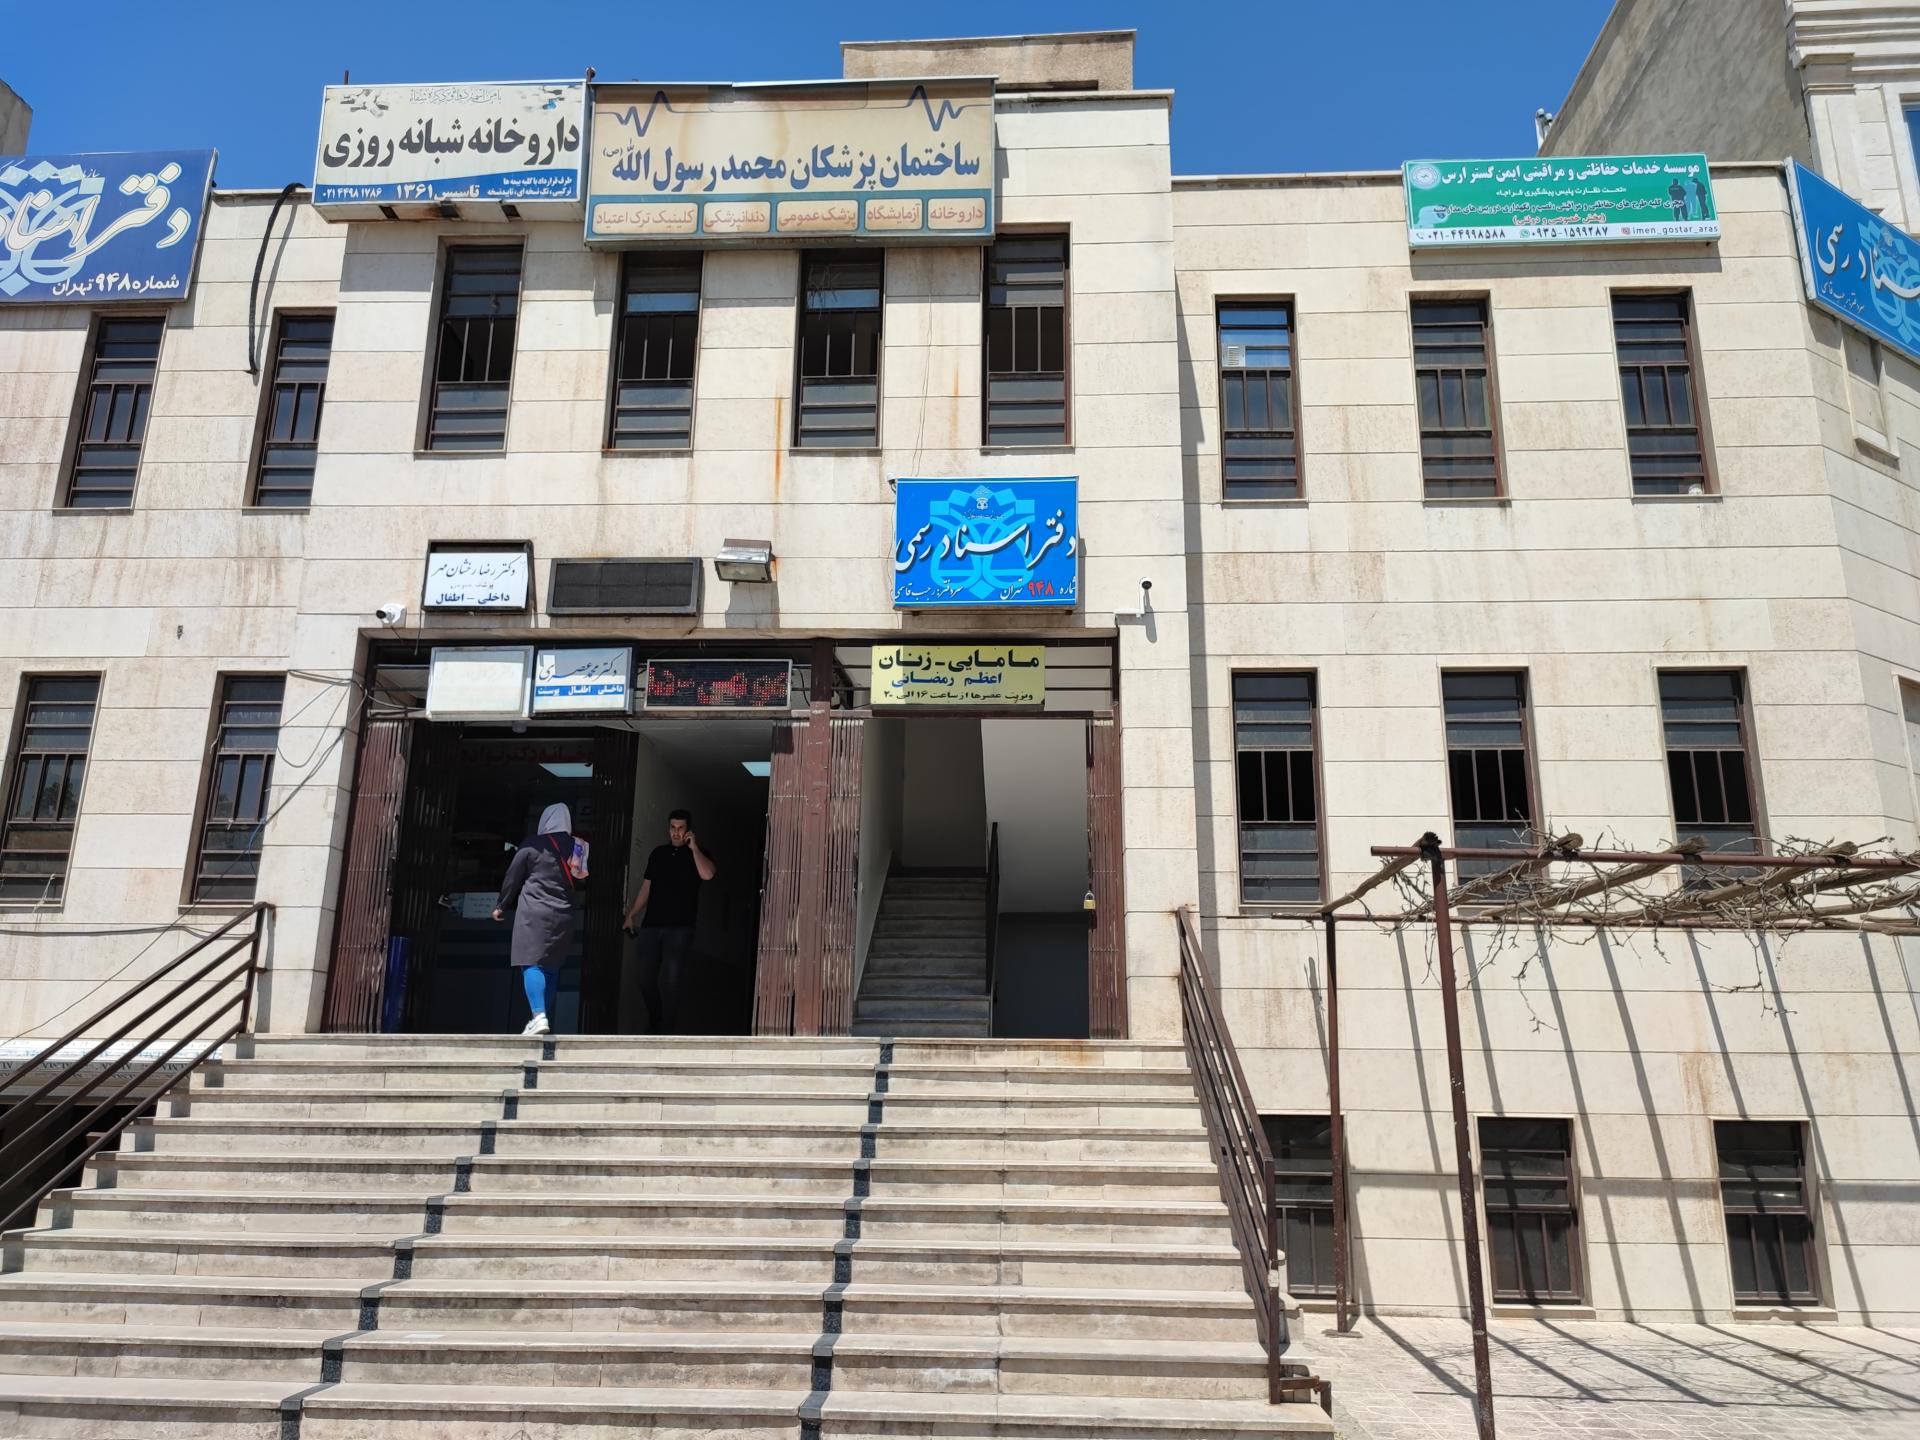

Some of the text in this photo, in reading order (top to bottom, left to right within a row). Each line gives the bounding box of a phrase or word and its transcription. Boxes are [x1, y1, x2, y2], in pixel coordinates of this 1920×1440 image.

[323, 116, 580, 168] داروخانه شبانه روزی
[612, 138, 651, 181] الله
[652, 146, 718, 192] رسول
[721, 154, 787, 181] محمد
[790, 144, 876, 191] پزشکان
[879, 141, 980, 188] ساختمان
[1441, 161, 1700, 184] موسسه خدمات حفاظتی و مراقبتی ایمن گستر ارس
[396, 183, 433, 200] ۱۳۶۱
[0, 162, 191, 263] دفتر اسنا
[596, 209, 695, 229] کلینیک ترک اعتیاد
[704, 209, 766, 231] دندانپزشکی
[778, 206, 856, 228] پزشک عمومی
[866, 203, 921, 224] آزمایشگاه
[929, 206, 984, 224] داروخانه
[1632, 225, 1718, 236] imen_gostar_aras
[52, 272, 180, 296] شماره ۹۴۸ تهران
[895, 509, 1076, 571] دفتر اسناد رسمی
[494, 554, 522, 580] دکتر
[435, 593, 465, 605] اطفال
[477, 592, 510, 605] داخلی
[1000, 578, 1024, 600] تهران
[1027, 581, 1055, 597] ۹۴۸
[592, 651, 624, 682] دکتر
[892, 671, 1003, 688] اعظم رمضانی
[537, 684, 624, 697] داخلی اطفال پوست
[897, 691, 915, 700] الی
[916, 691, 928, 699] ۱۶
[929, 691, 959, 699] ساعت
[959, 692, 970, 700] از
[970, 691, 1001, 700] عصرها
